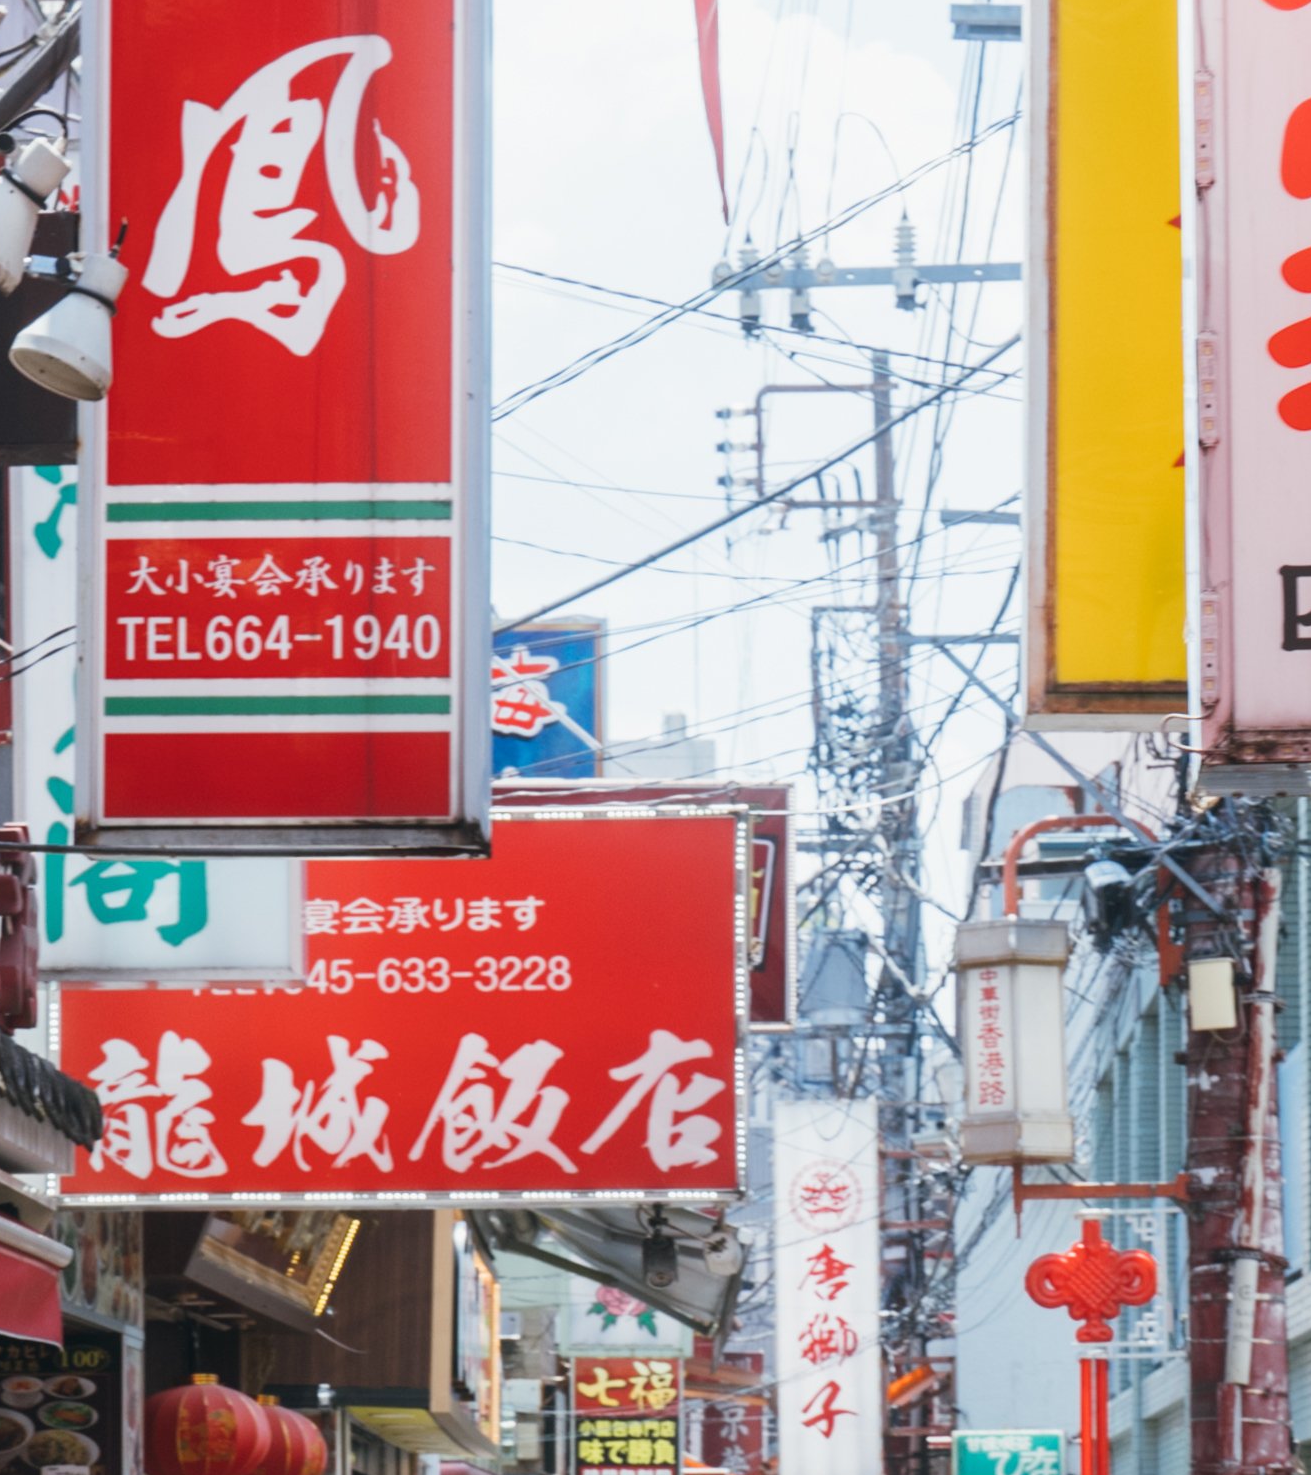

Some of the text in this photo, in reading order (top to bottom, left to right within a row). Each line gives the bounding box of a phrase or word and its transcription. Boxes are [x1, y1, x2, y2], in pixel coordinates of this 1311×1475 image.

[125, 554, 436, 600] 大小宴会承ります
[295, 955, 574, 996] 45-633-3228
[89, 1027, 727, 1182] 龍城飯店
[577, 1360, 679, 1411] 七福
[578, 1438, 676, 1464] 味で勝負
